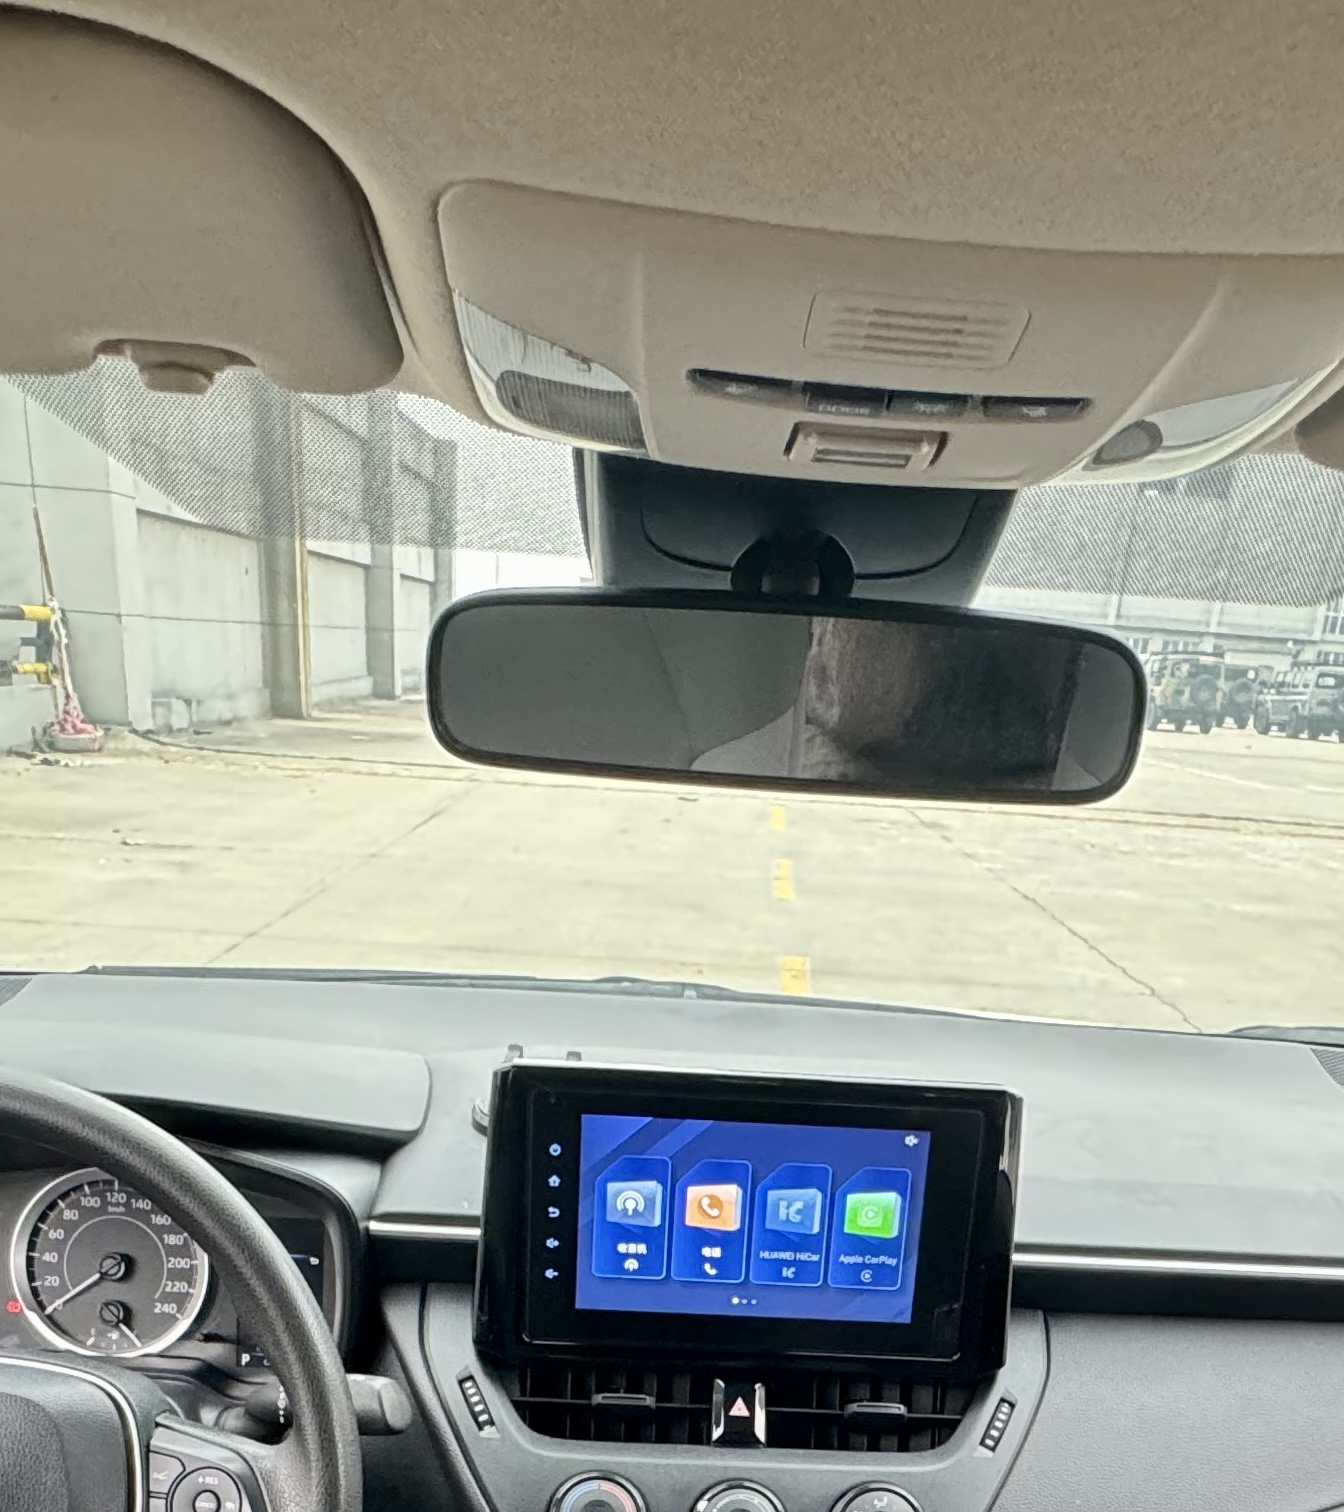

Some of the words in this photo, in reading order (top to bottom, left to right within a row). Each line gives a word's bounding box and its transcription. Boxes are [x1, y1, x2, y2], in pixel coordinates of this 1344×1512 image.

[80, 1196, 101, 1208] 100
[106, 1192, 127, 1204] 120
[131, 1199, 152, 1210] 140
[63, 1209, 79, 1220] 80
[150, 1214, 172, 1225] 160
[48, 1229, 65, 1240] 60
[162, 1234, 184, 1245] 180
[42, 1252, 59, 1263] 40
[759, 1251, 795, 1261] HUAWEI
[838, 1253, 864, 1265] Apple
[864, 1254, 898, 1267] CarPlay
[167, 1257, 191, 1268] 200
[44, 1276, 60, 1287] 20
[164, 1281, 188, 1293] 220
[154, 1302, 178, 1314] 240
[241, 1353, 251, 1366] P
